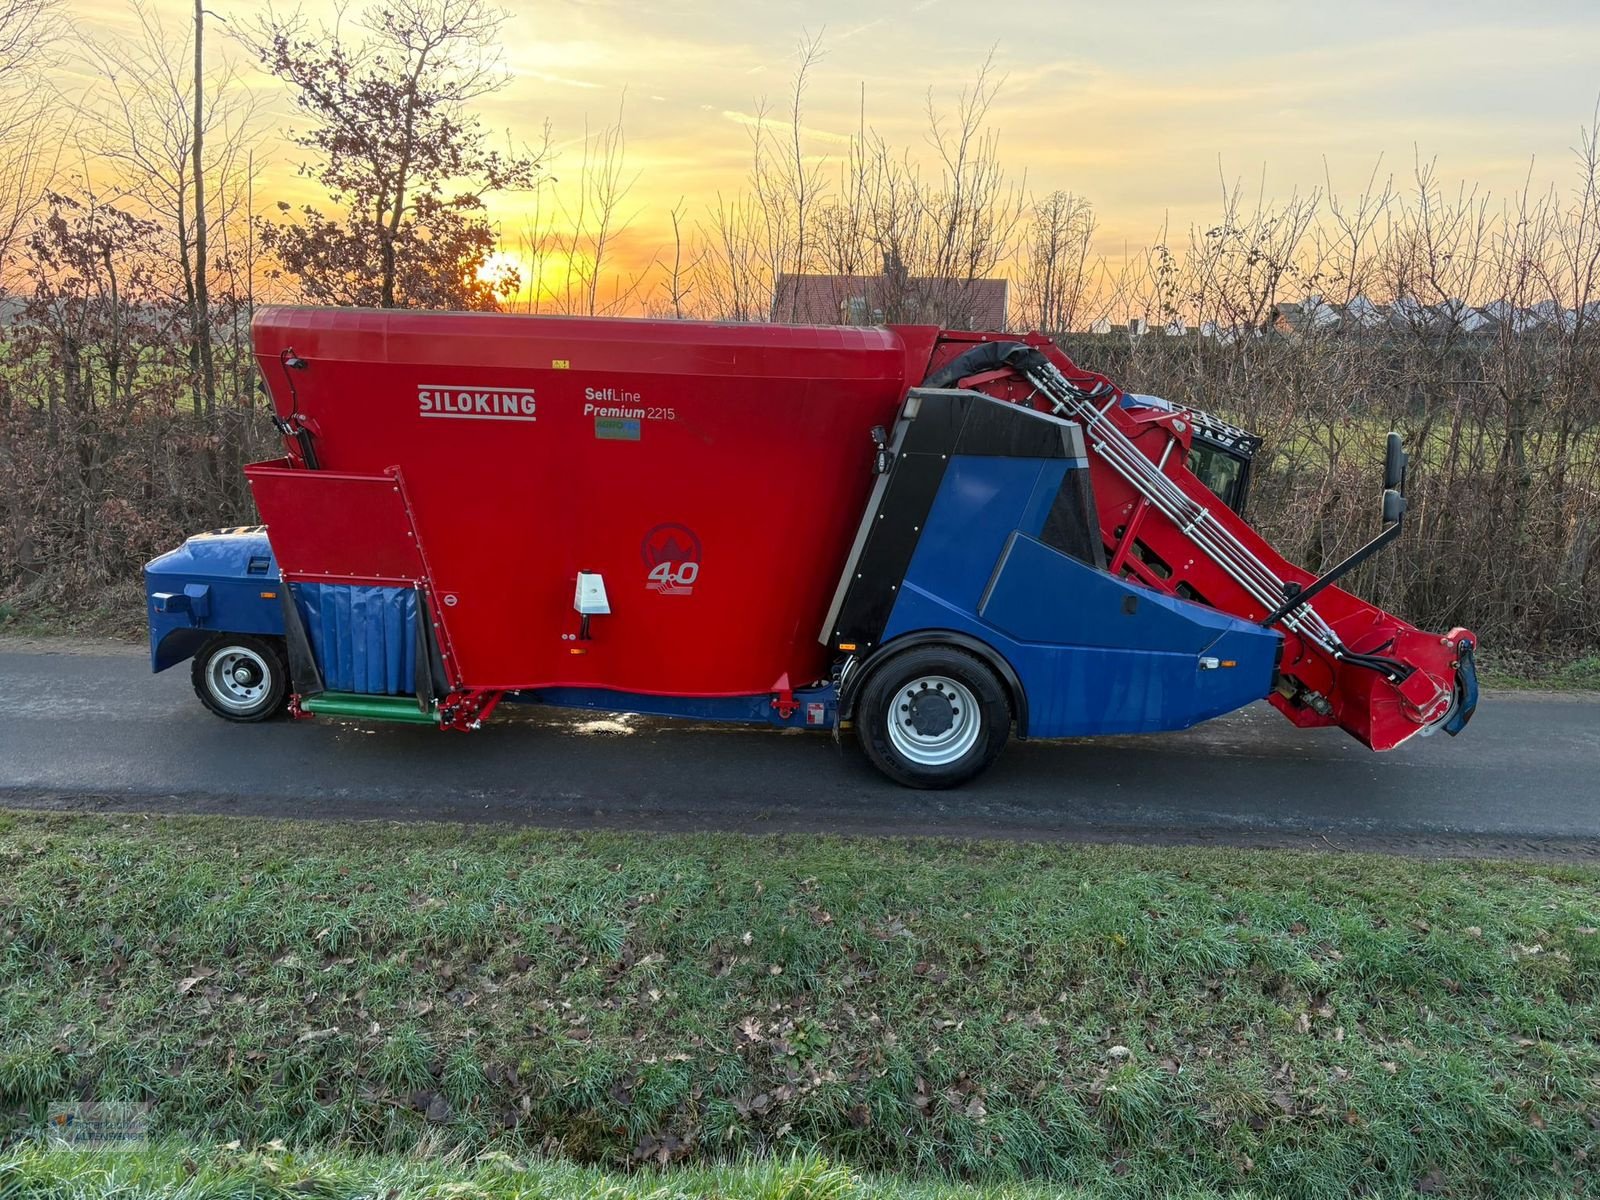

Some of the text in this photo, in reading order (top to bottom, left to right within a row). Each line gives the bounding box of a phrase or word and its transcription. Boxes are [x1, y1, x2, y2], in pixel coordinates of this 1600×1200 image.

[418, 391, 536, 415] SILOKING
[585, 387, 641, 402] SelfLine
[583, 403, 676, 420] Premium 2215
[648, 561, 699, 585] 4.0
